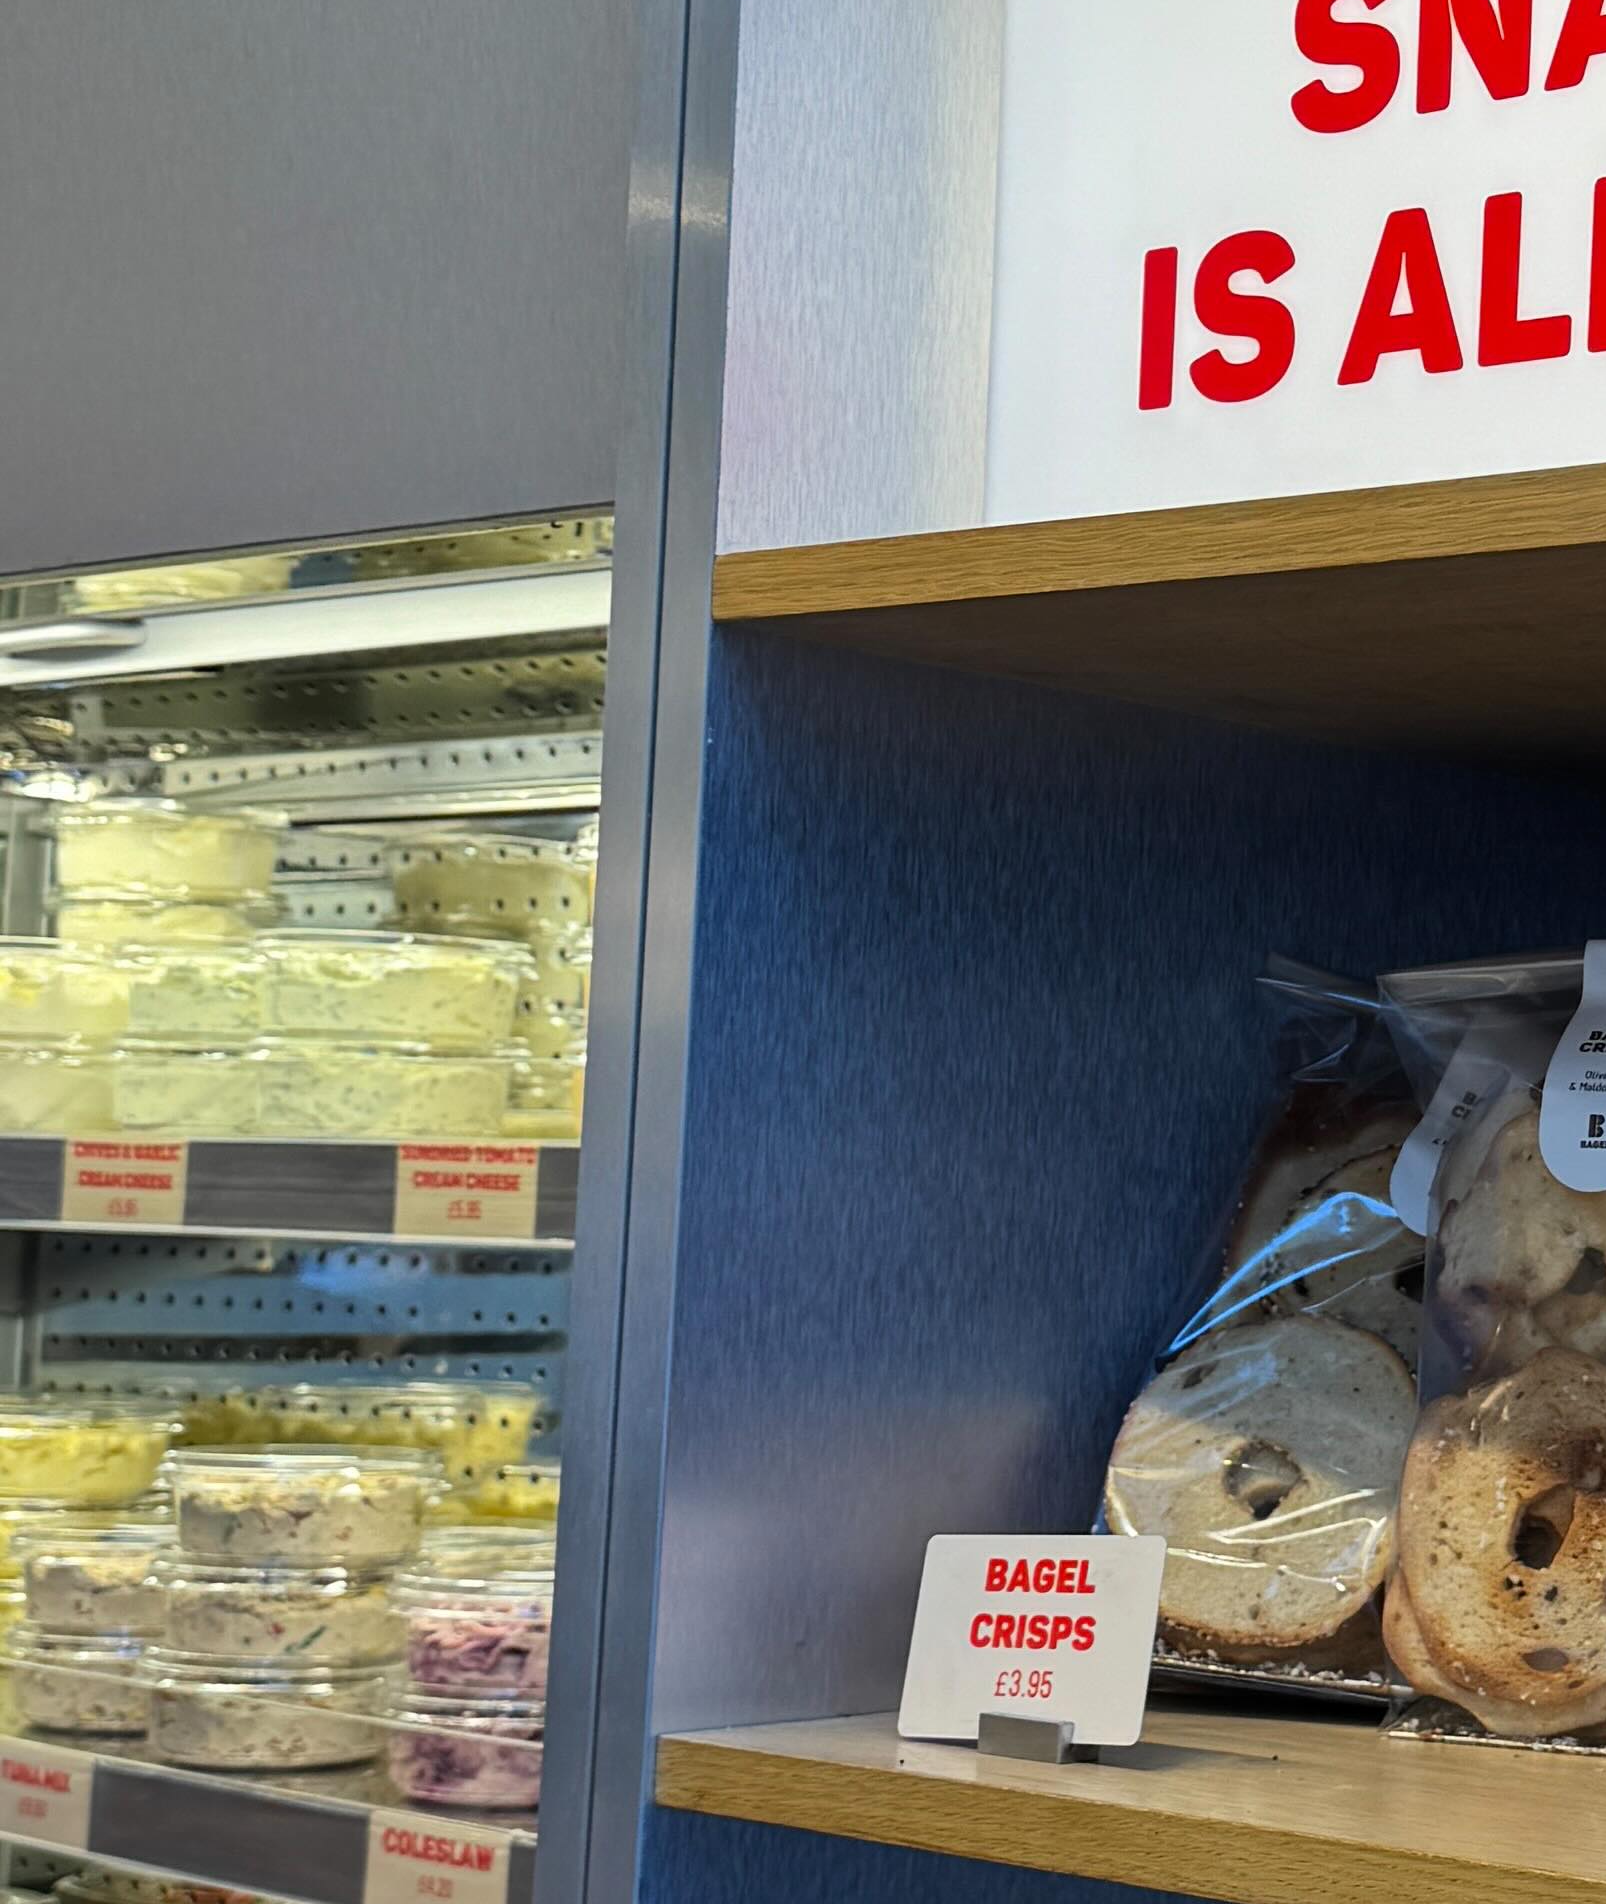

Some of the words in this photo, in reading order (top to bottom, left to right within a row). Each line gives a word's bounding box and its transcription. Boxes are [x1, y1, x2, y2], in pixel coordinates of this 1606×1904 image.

[1137, 229, 1297, 410] IS
[1588, 1113, 1606, 1138] B
[985, 1558, 1096, 1594] BAGEL
[969, 1613, 1096, 1651] CRISPS
[994, 1670, 1053, 1698] £3.95
[383, 1827, 494, 1872] COLESLAW
